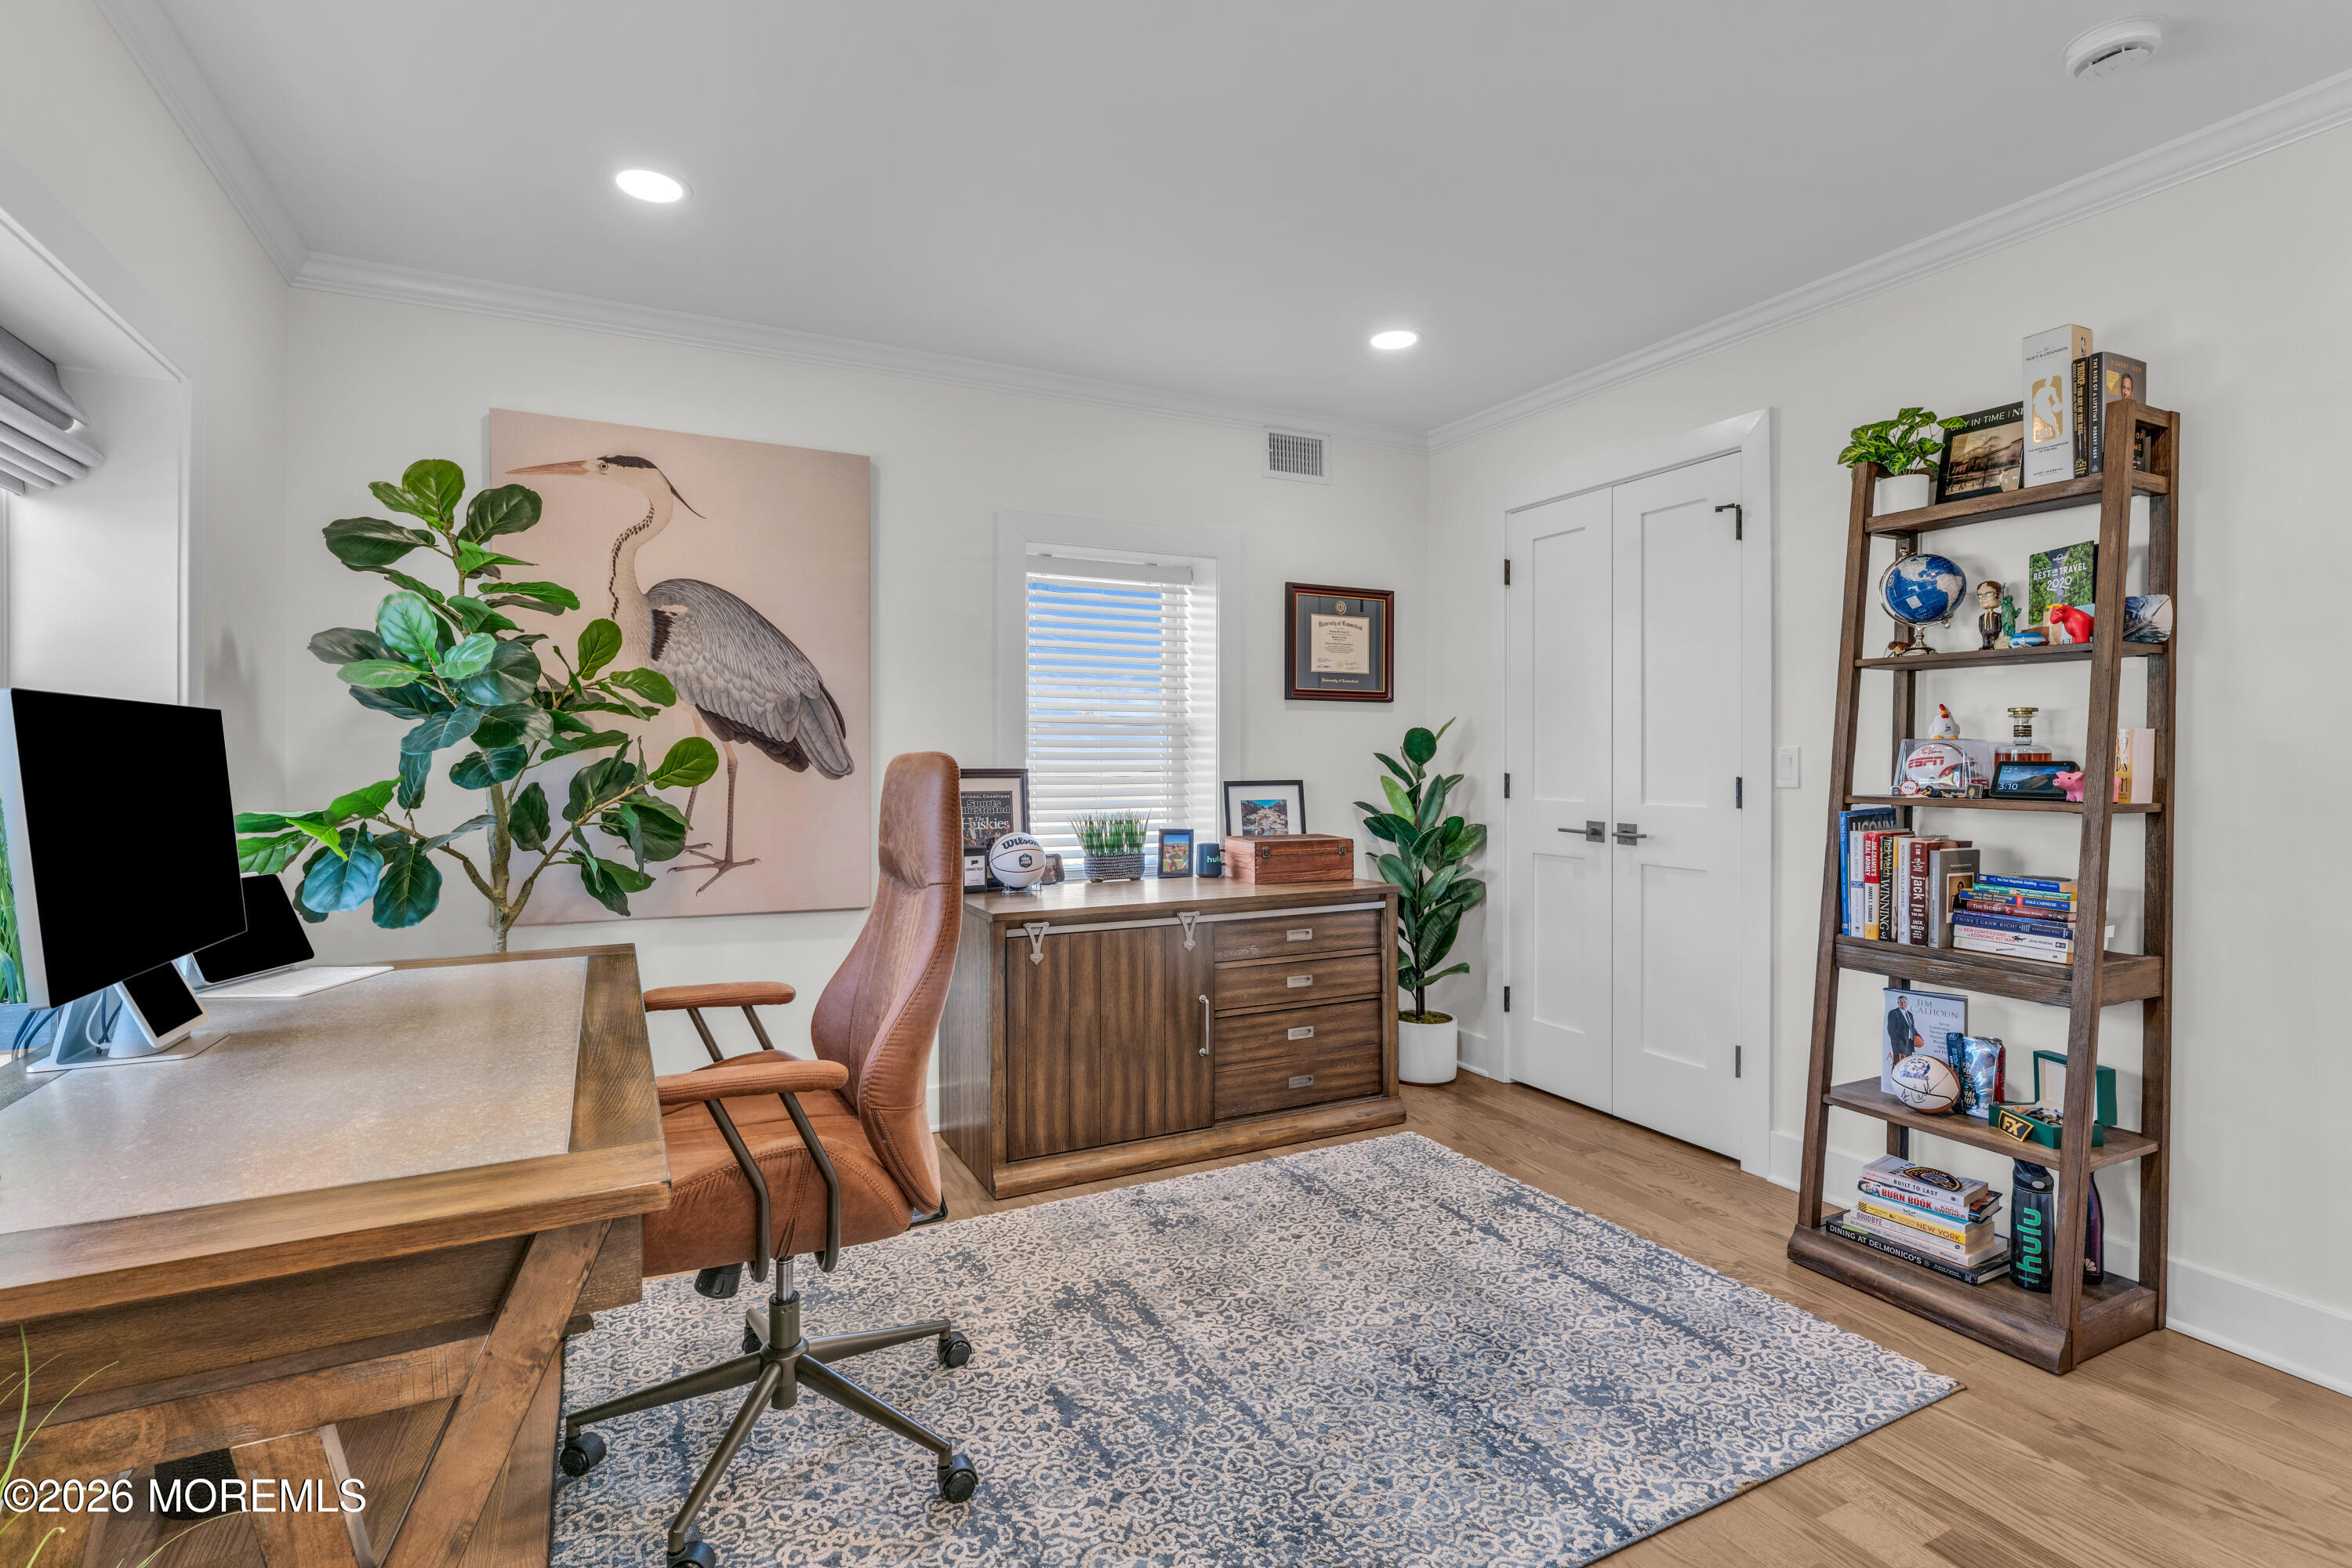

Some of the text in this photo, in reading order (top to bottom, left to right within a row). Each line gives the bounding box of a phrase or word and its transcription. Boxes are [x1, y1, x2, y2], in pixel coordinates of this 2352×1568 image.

[2044, 347, 2068, 356] CHANDON
[1971, 417, 1980, 426] IN
[1984, 412, 2005, 423] TIME
[2034, 569, 2051, 580] BEST
[2059, 562, 2087, 575] TRAVEL
[2046, 575, 2072, 591] 2020
[1908, 756, 1944, 769] ESPN
[966, 800, 1002, 808] Sports
[963, 817, 1010, 829] Huskies
[1002, 837, 1040, 850] Wilson
[1883, 839, 1893, 878] Jack Welch
[1880, 880, 1889, 930] WINNING
[1918, 999, 1932, 1008] JIM
[1910, 1006, 1958, 1019] CALHOUN
[1886, 1052, 1894, 1062] A
[2002, 1116, 2024, 1136] FX
[1894, 1179, 1910, 1189] BUILT
[1922, 1188, 1938, 1196] LAST
[1882, 1189, 1932, 1210] BURN BOOK
[1857, 1212, 1882, 1225] GOODBYE
[1934, 1207, 1965, 1218] SWISHER
[1916, 1223, 1960, 1242] NEW YORK
[1830, 1225, 1855, 1240] DINING
[1869, 1239, 1922, 1264] DELMONICO'S
[1904, 1238, 1918, 1247] American
[2016, 1207, 2042, 1274] hulu
[2018, 1275, 2038, 1284] contigo
